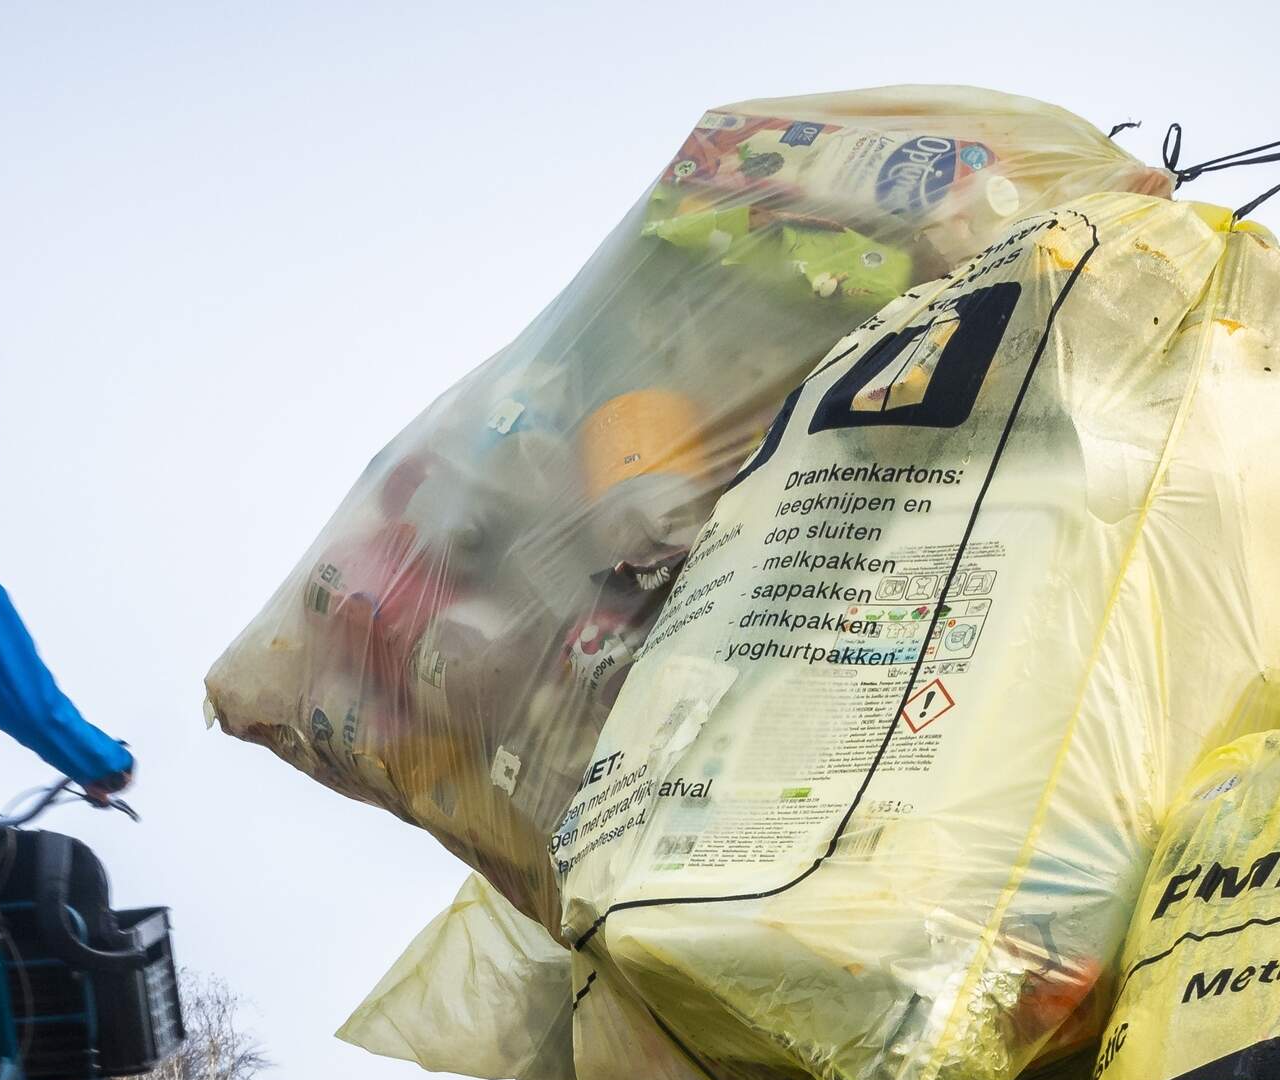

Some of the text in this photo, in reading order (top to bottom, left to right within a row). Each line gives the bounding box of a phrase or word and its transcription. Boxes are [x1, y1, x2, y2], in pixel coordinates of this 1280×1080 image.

[785, 463, 964, 491] Drankenkartons:
[775, 493, 932, 517] leegknijpen en
[764, 521, 882, 545] dop sluiten
[762, 551, 896, 574] melkpakken
[751, 581, 872, 604] sappakken
[739, 609, 878, 635] drinkpakken
[724, 638, 896, 665] yoghurtpakken
[658, 777, 713, 798] afval
